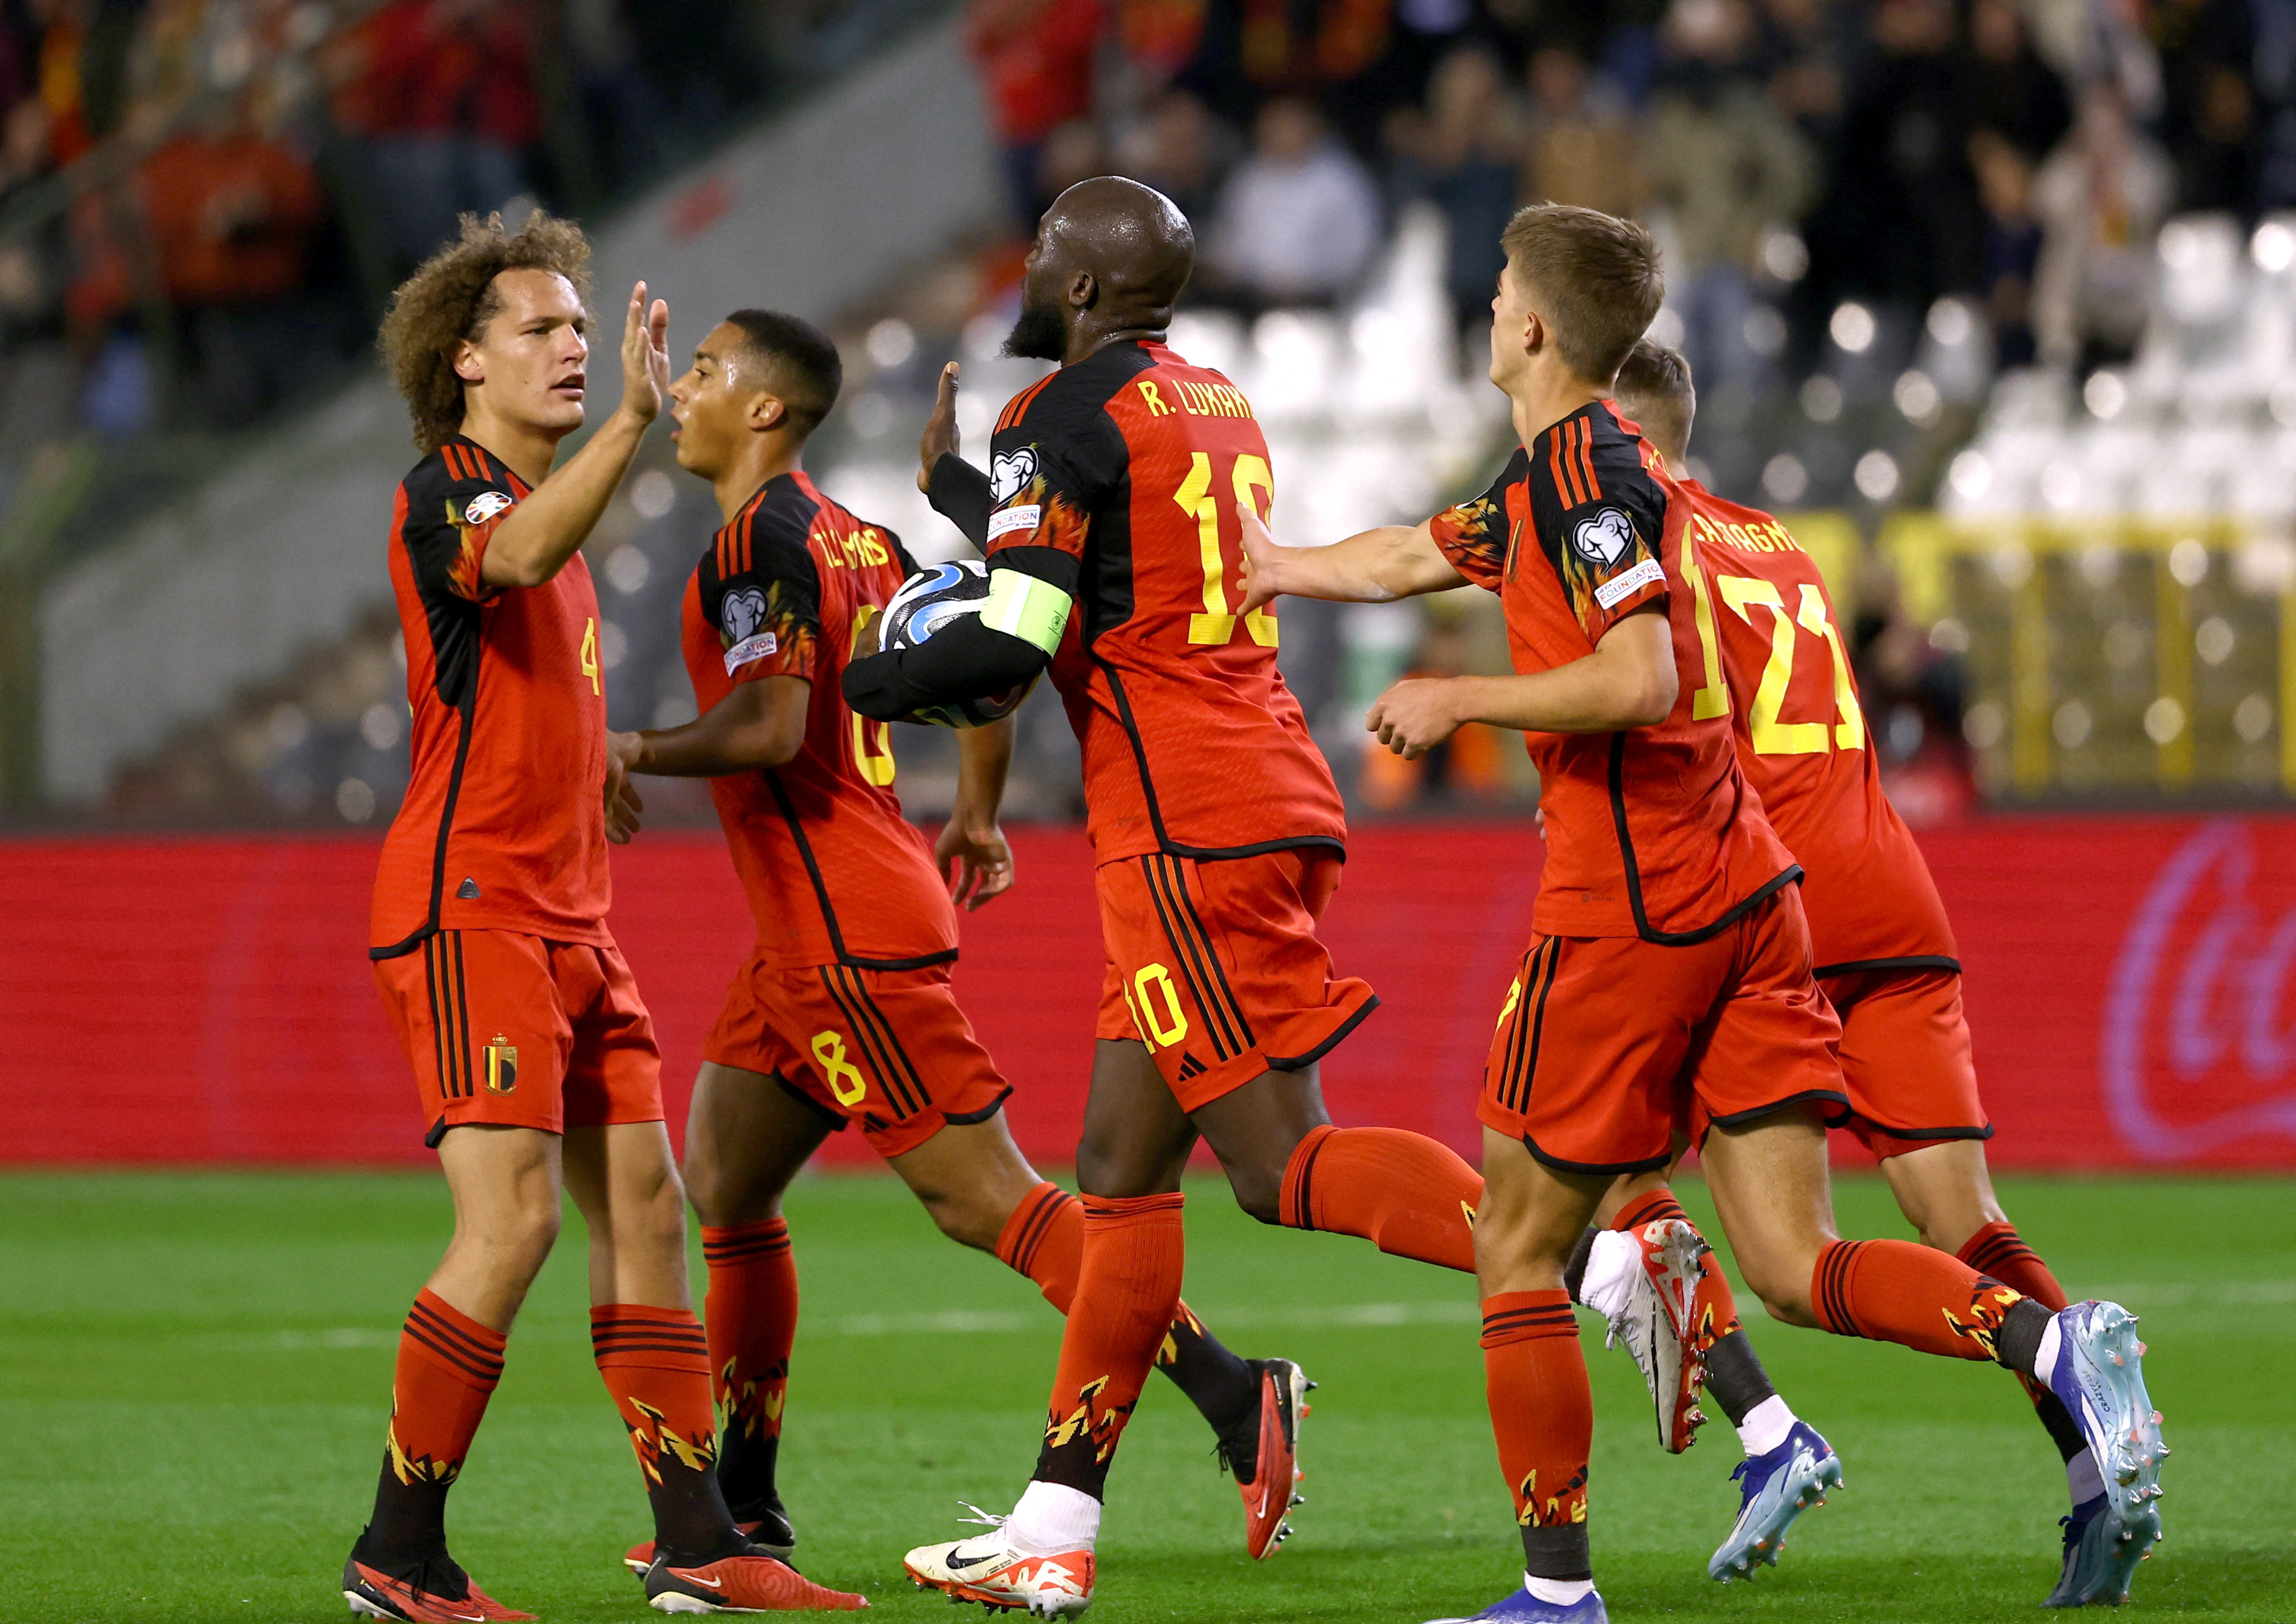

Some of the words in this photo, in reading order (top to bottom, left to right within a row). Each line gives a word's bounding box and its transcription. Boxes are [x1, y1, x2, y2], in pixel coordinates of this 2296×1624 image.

[1137, 380, 1176, 417] R.
[1171, 380, 1256, 421] LUKAK
[989, 512, 1037, 532] OUNDATION
[1600, 565, 1662, 602] FOUNDATIO
[580, 617, 600, 696] 4
[1717, 574, 1865, 755] 21
[811, 1030, 866, 1107] 8
